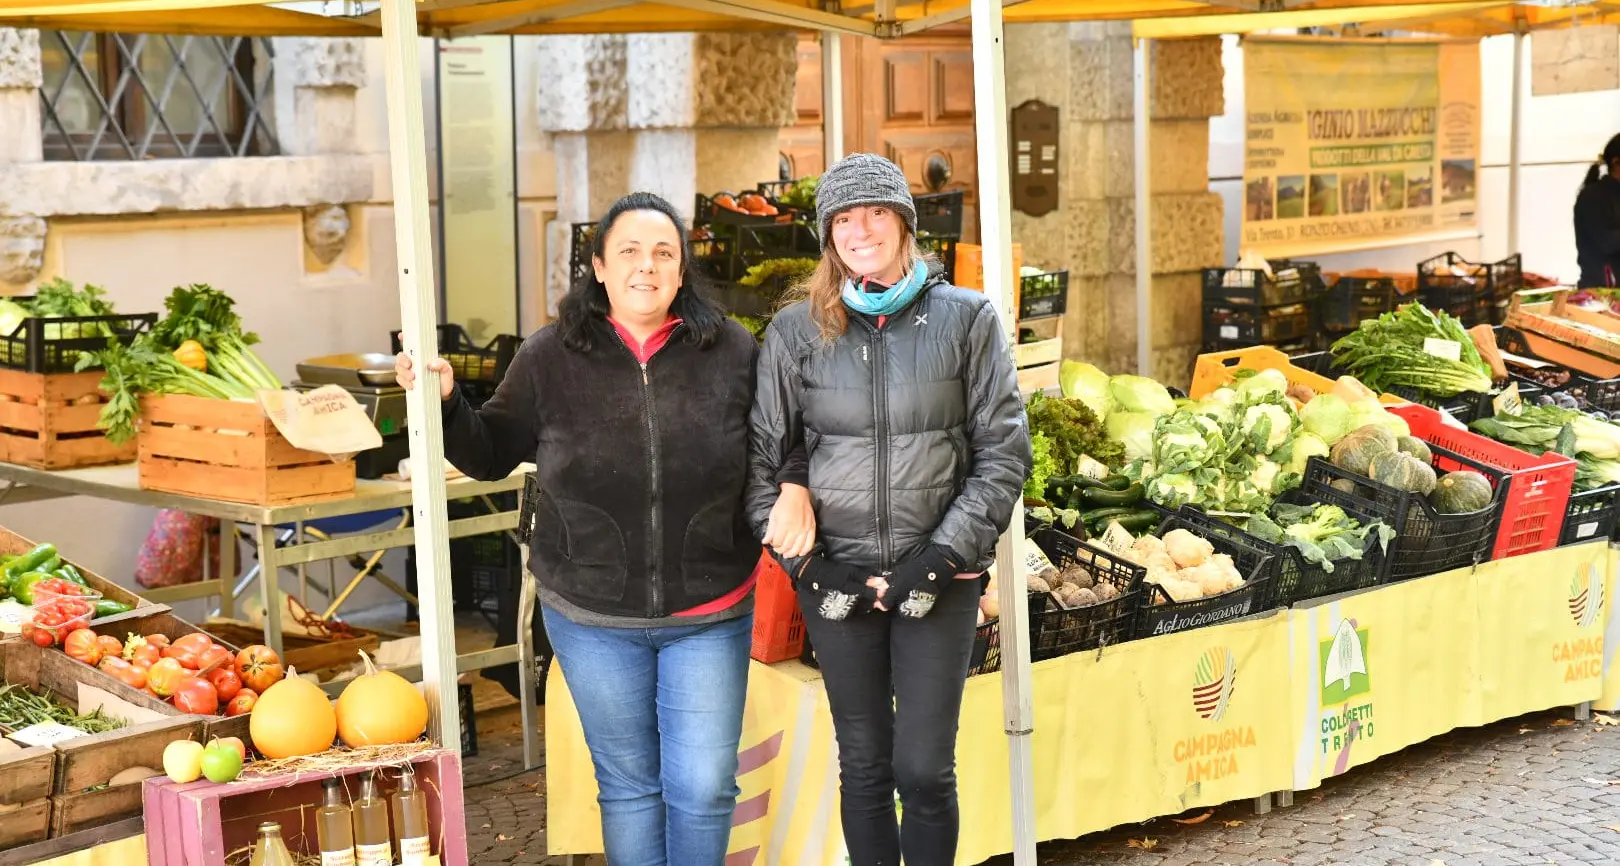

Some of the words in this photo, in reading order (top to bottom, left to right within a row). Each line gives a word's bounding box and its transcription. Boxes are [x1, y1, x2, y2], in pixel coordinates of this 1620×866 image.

[313, 402, 346, 415] AMICA
[1564, 658, 1602, 683] AMIC
[1173, 725, 1256, 763] CAMPAGNA
[1185, 752, 1239, 785] AMICA
